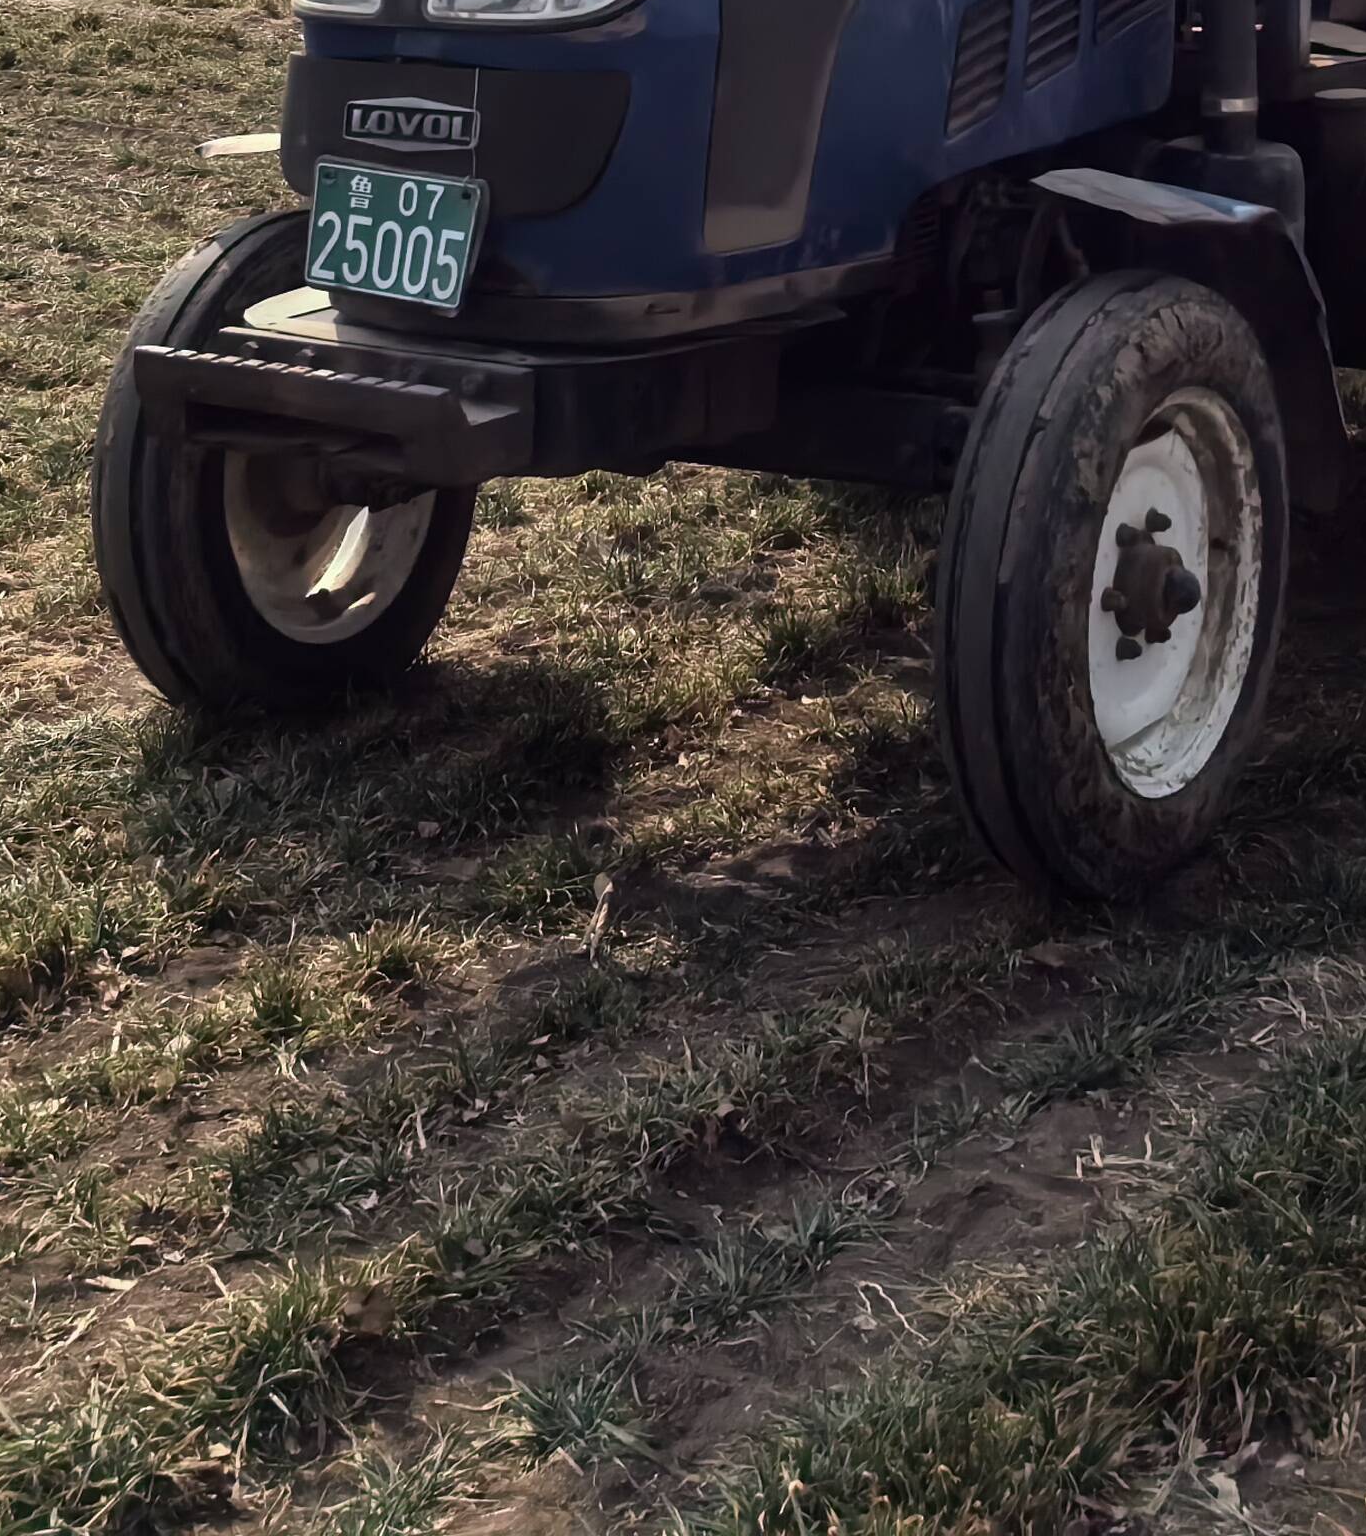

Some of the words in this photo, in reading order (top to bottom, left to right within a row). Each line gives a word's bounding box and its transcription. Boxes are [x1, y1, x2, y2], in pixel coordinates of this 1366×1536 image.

[351, 107, 471, 142] LOVOL
[347, 173, 374, 210] 鲁
[397, 180, 446, 221] 07
[310, 210, 466, 300] 25005
